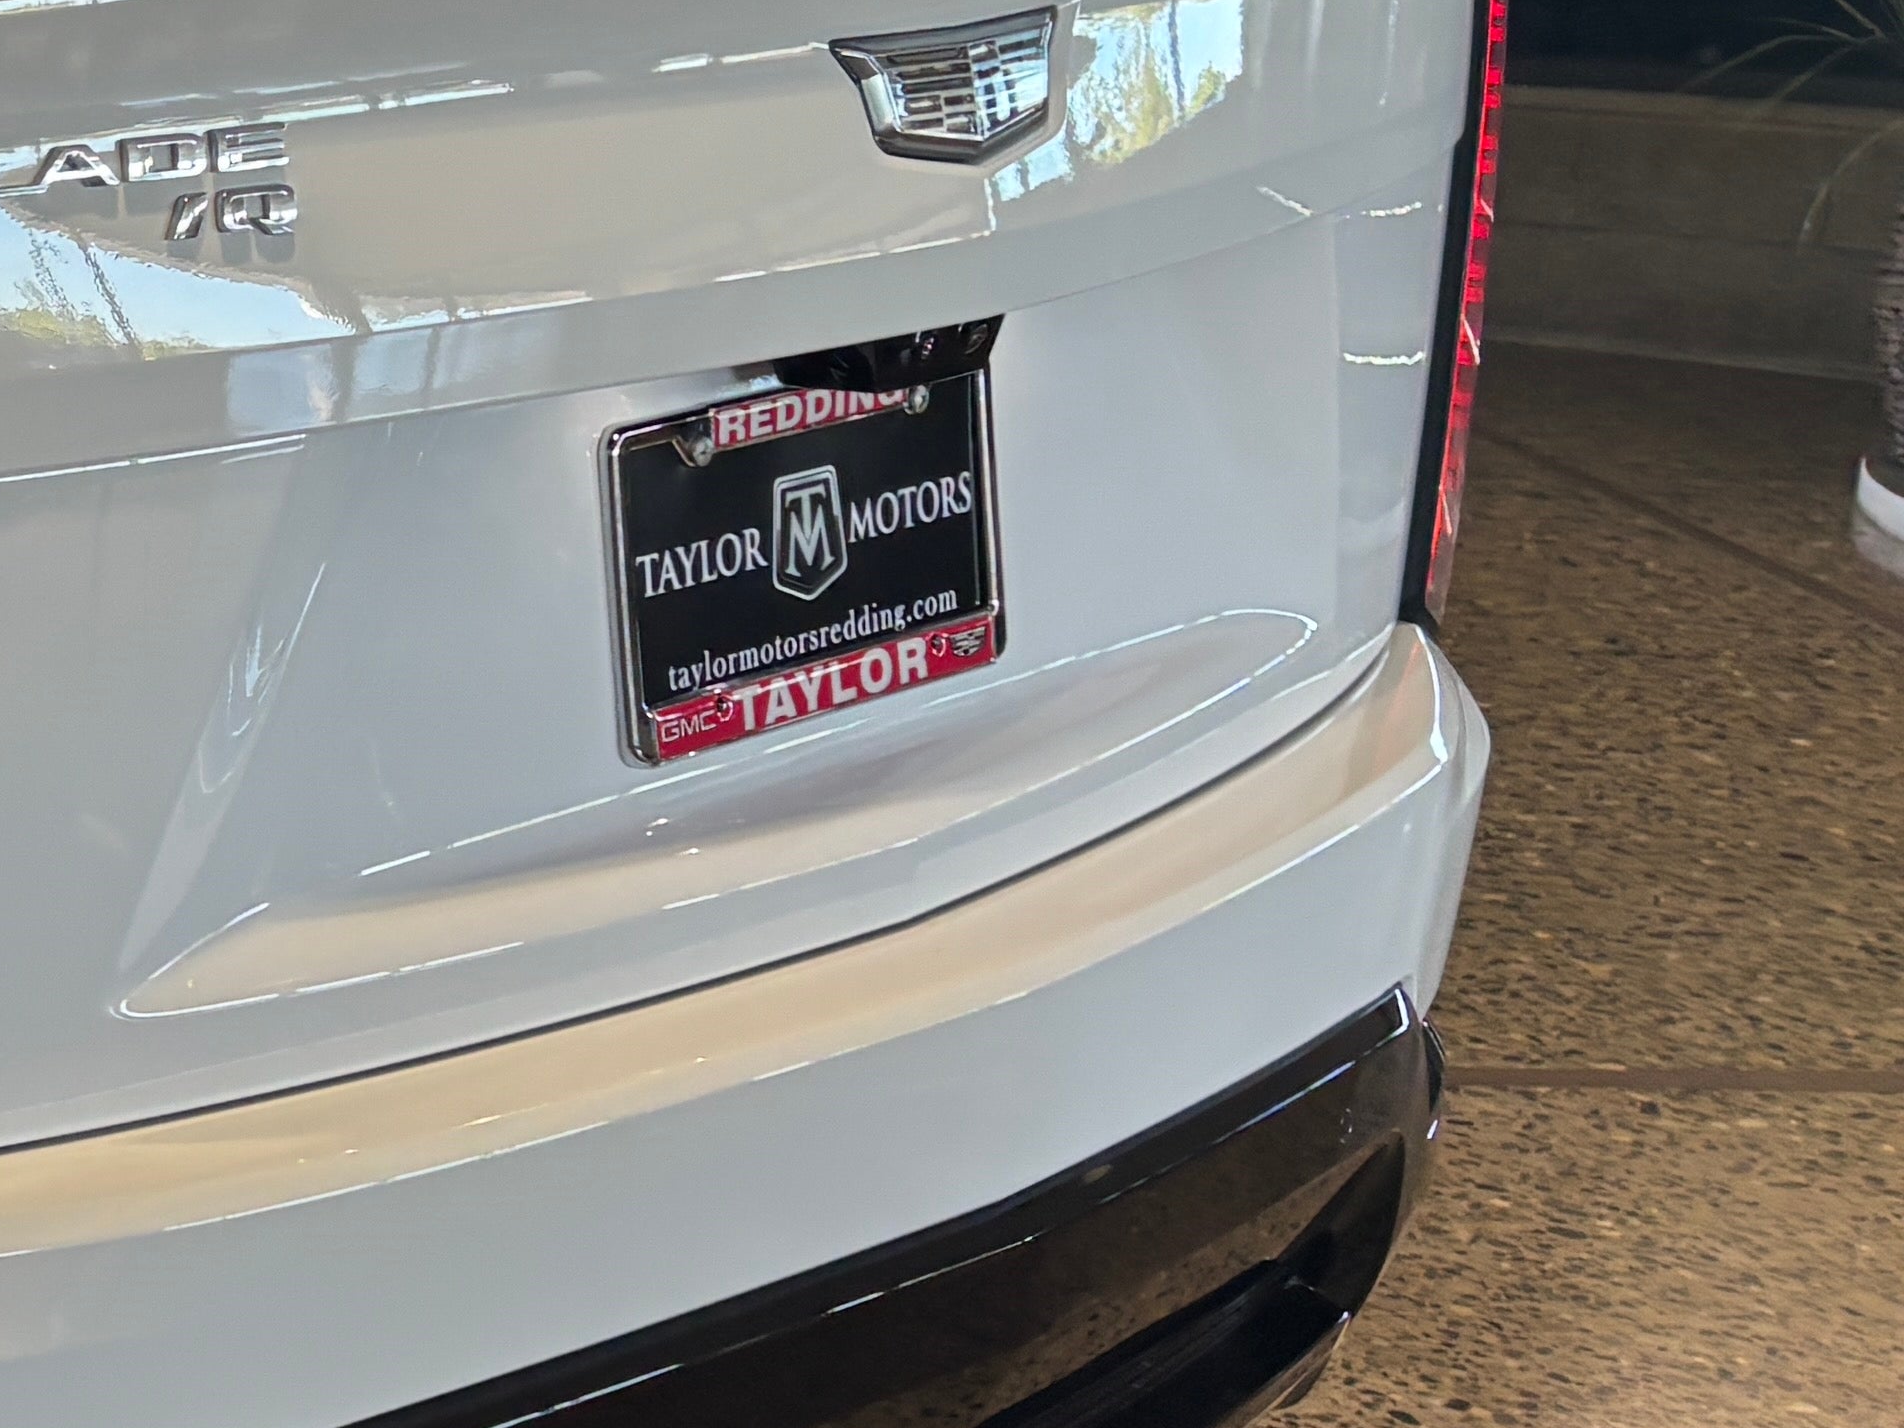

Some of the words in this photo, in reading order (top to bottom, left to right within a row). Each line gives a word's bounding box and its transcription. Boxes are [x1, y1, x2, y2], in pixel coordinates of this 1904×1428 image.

[165, 184, 297, 240] IQ
[635, 527, 769, 598] TAYLOR
[847, 471, 973, 544] MOTORS
[660, 708, 717, 743] GMC
[732, 636, 929, 732] TAYLOR
[668, 588, 958, 692] taylormotorsredding.com
